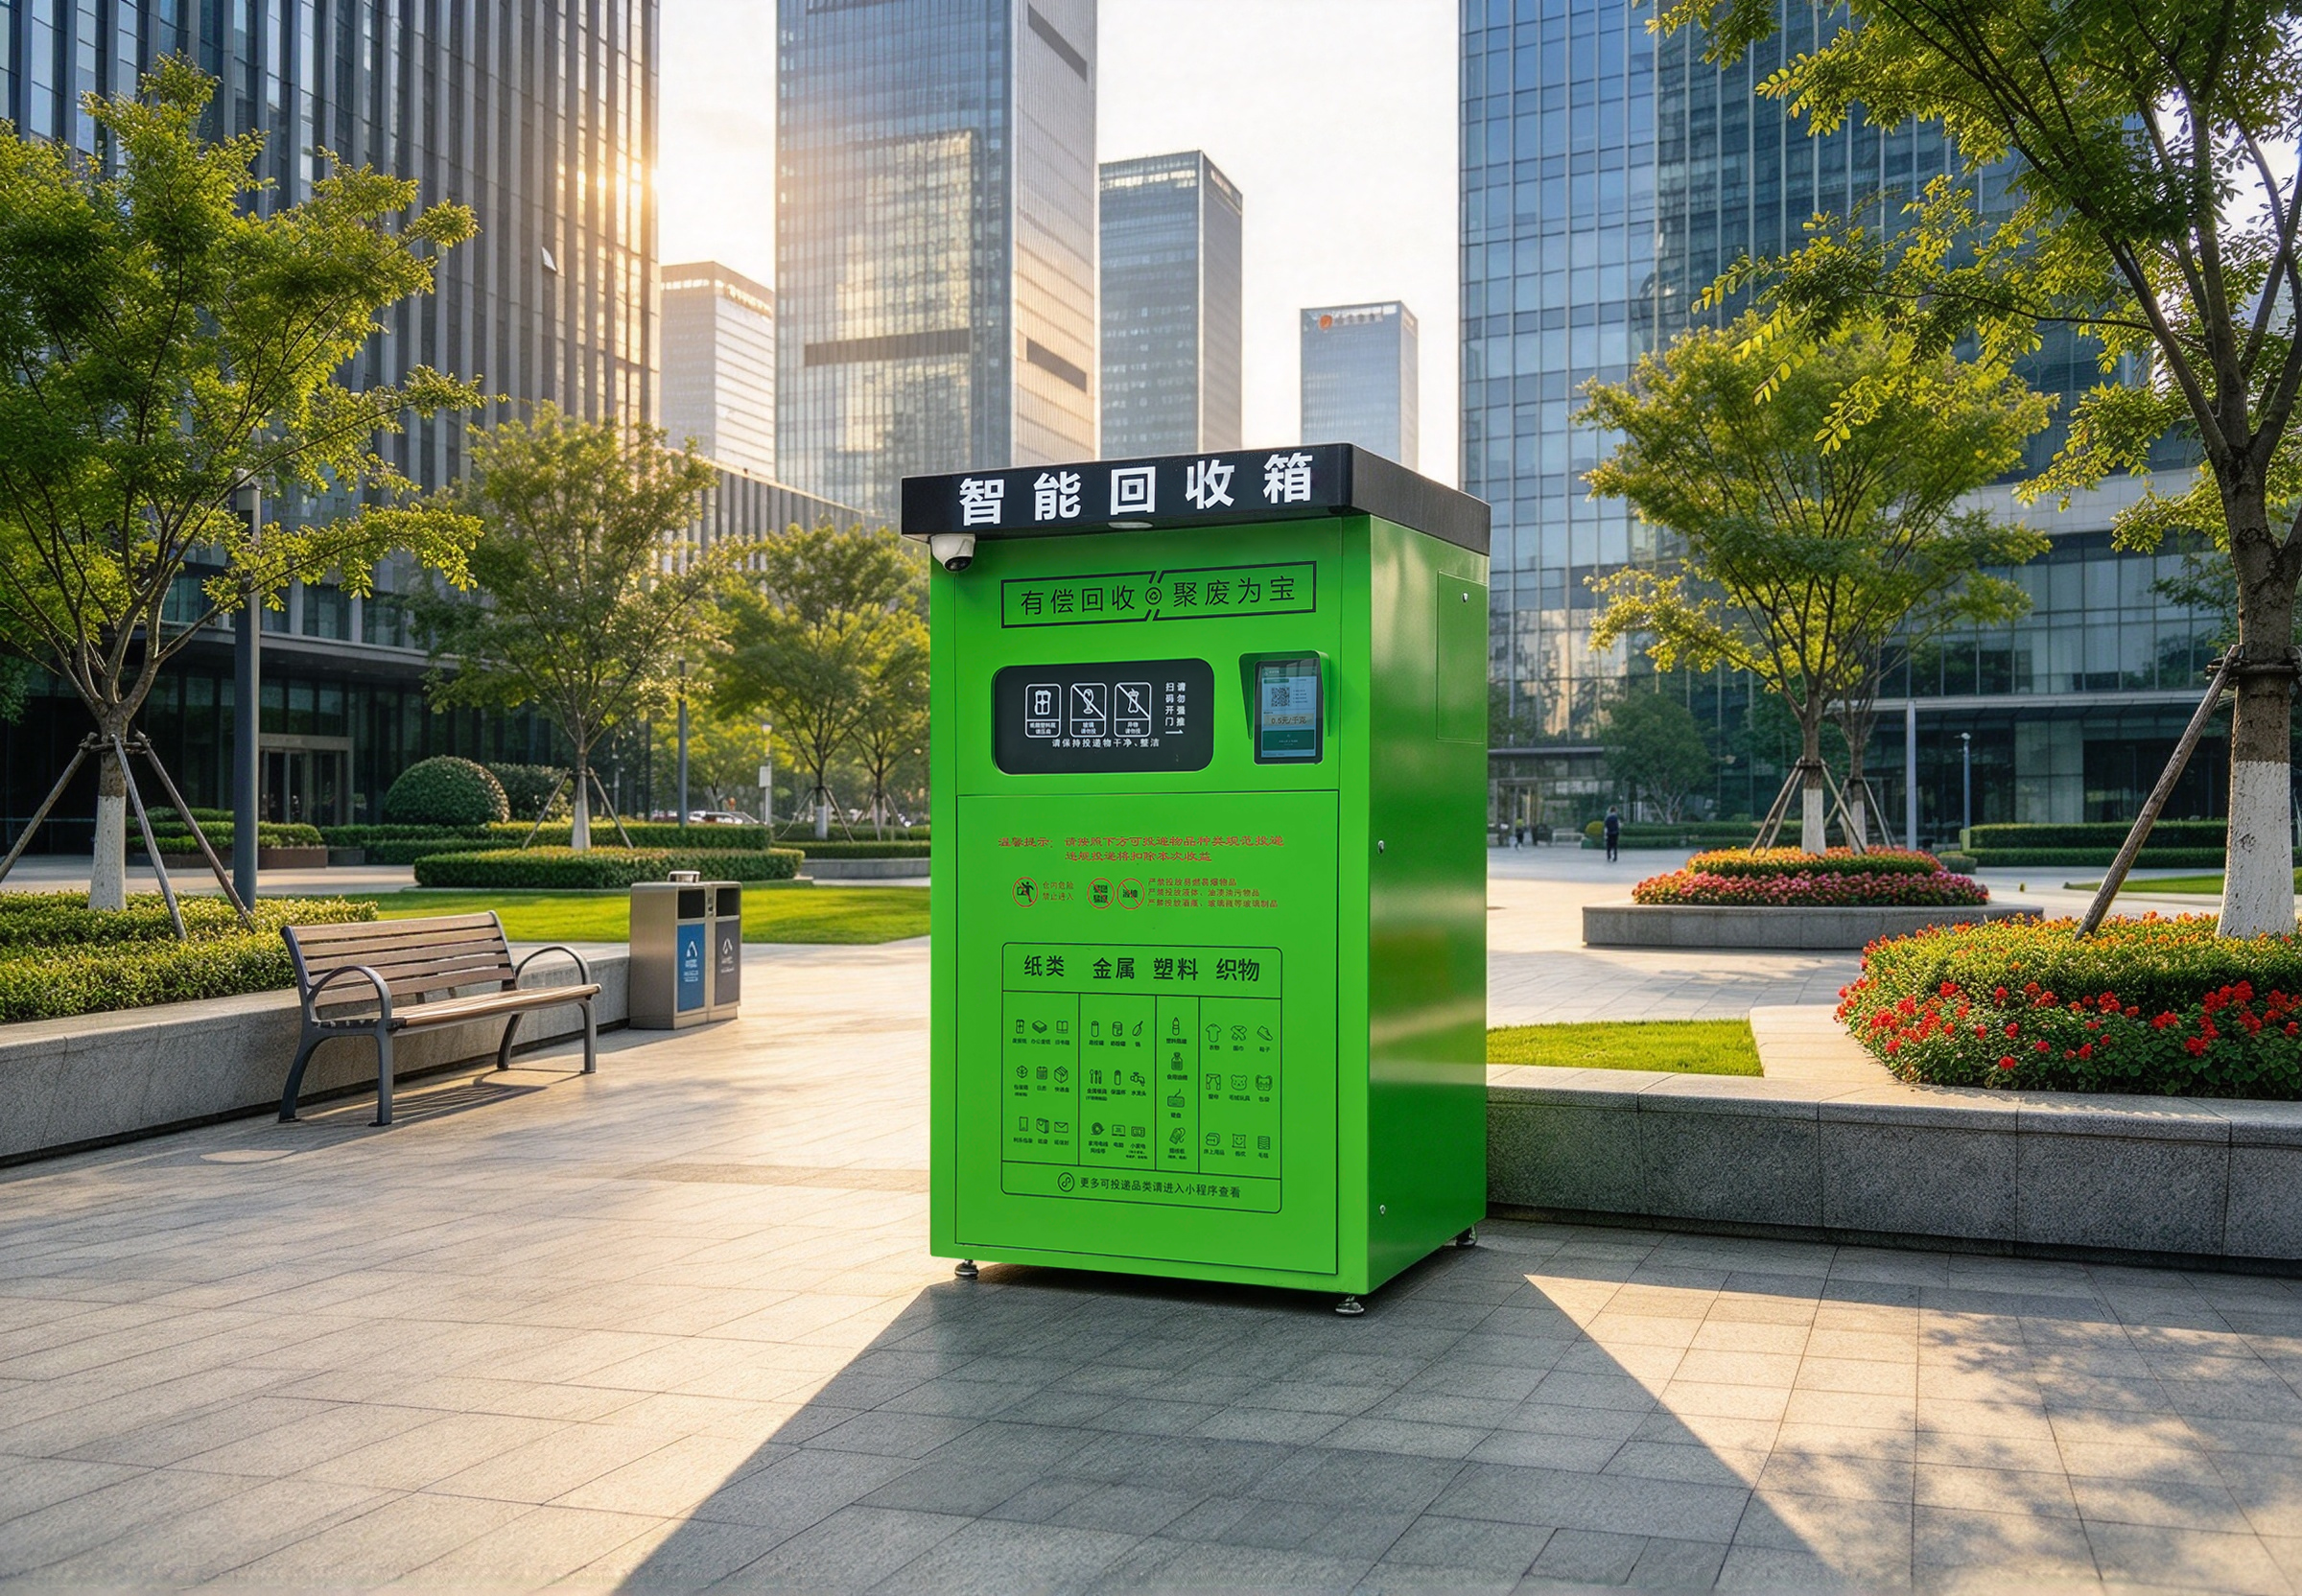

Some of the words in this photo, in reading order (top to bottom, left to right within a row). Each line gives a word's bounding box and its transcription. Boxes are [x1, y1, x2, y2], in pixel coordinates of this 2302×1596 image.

[959, 453, 1313, 527] 智能回收箱
[1021, 583, 1136, 616] 有偿回收
[1173, 575, 1296, 608] 聚废为宝
[1164, 682, 1175, 727] 扫码开门
[1177, 682, 1186, 727] 请勿强推
[1051, 738, 1160, 748] 请保持投递物干净、整洁
[1065, 851, 1212, 862] 违规投递将扣除本次收益
[1042, 880, 1074, 890] 仓内危险
[1042, 892, 1074, 902] 禁止进入
[1023, 954, 1066, 977] 纸类
[1092, 956, 1136, 980] 金属
[1153, 956, 1199, 981] 塑料
[1215, 957, 1260, 982] 织物
[1080, 1177, 1241, 1199] 更多可投递品类请进入小程序查看
